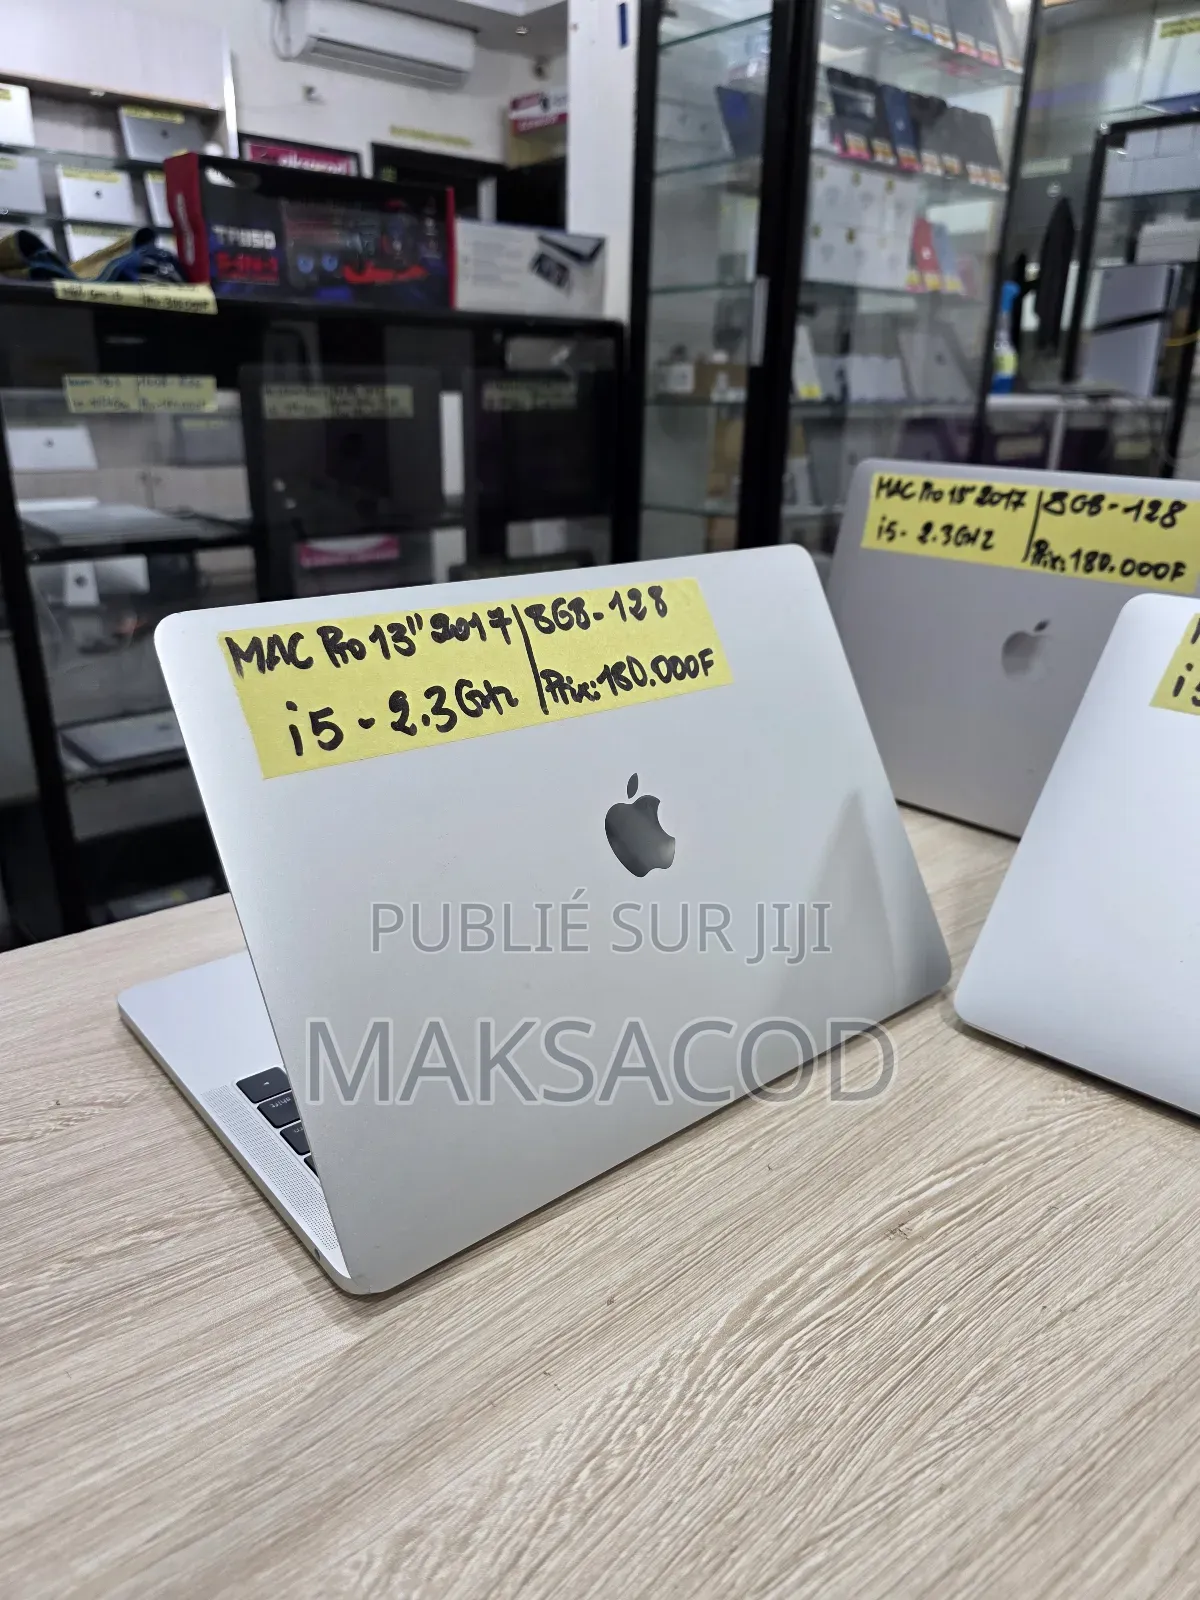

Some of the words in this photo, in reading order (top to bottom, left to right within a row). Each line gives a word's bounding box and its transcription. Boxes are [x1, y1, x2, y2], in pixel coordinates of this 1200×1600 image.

[875, 476, 917, 501] MAC
[919, 480, 944, 503] Pro
[974, 484, 1027, 512] 2017
[224, 631, 315, 679] MAC
[316, 624, 368, 669] Pro
[429, 606, 513, 645] 2017
[285, 700, 345, 757] i5
